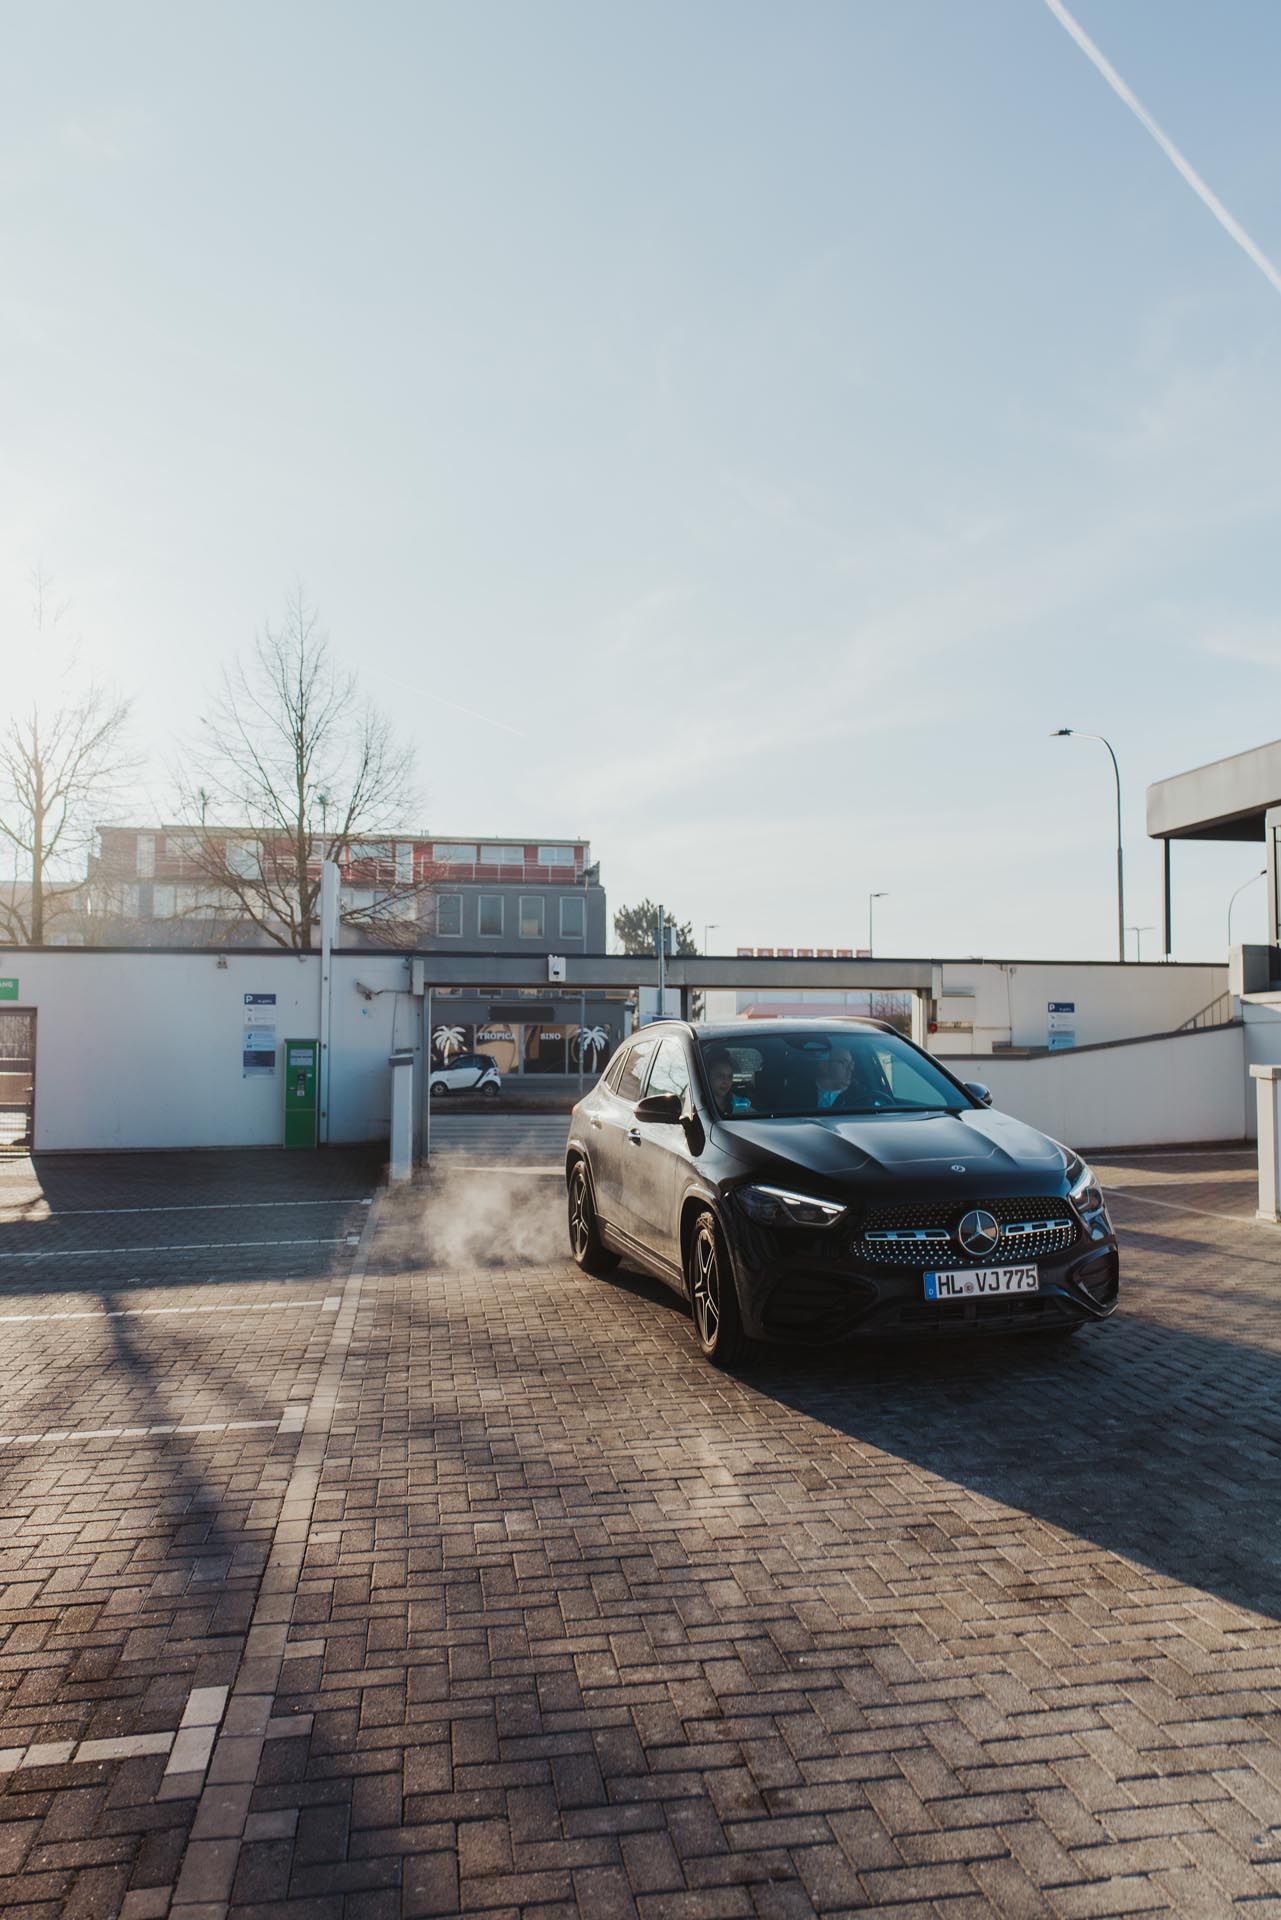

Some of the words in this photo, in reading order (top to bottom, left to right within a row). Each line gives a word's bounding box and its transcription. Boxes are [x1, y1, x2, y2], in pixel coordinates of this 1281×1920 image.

[246, 995, 253, 1003] P
[1049, 1003, 1055, 1011] P
[938, 1274, 963, 1295] HL
